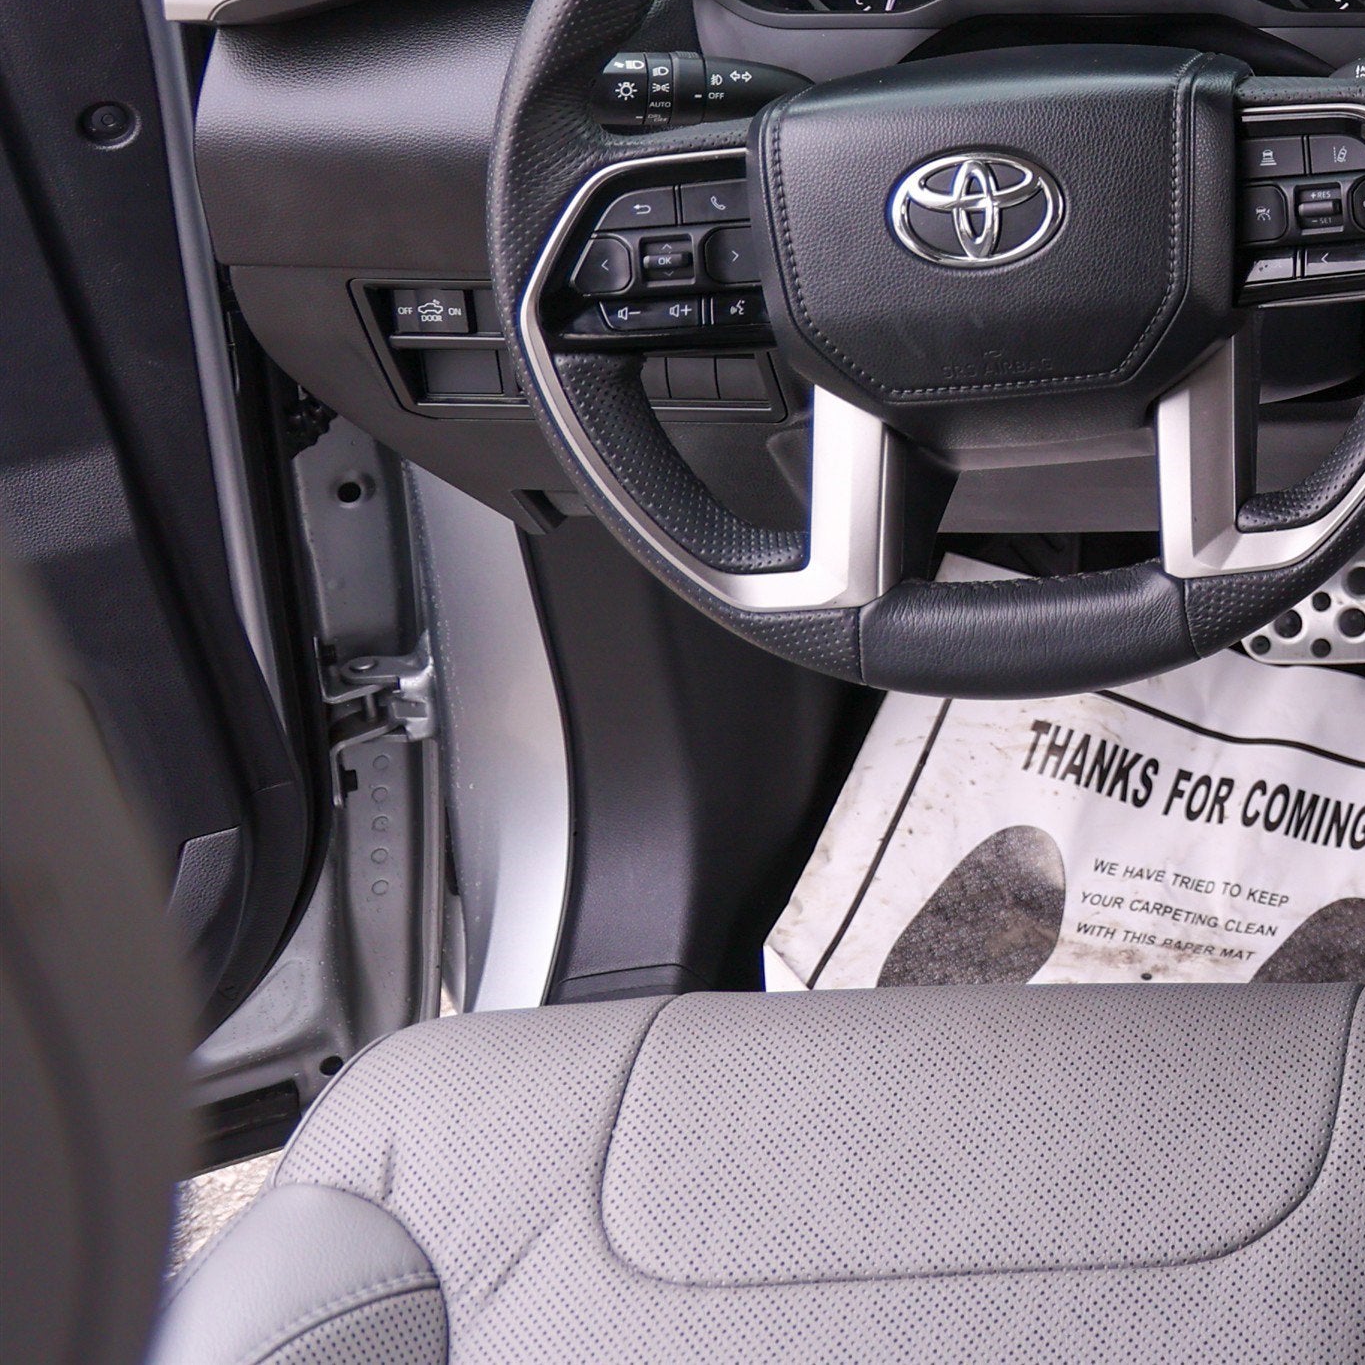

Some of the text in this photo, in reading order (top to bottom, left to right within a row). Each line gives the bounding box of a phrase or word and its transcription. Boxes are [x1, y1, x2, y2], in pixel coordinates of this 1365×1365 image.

[708, 92, 724, 100] OFF
[658, 256, 671, 265] OK
[397, 306, 413, 315] OFF
[448, 307, 462, 316] ON
[1021, 719, 1159, 809] THANKS
[1161, 768, 1234, 824] FOR
[1093, 858, 1290, 908] WE HAVE TRIED TO KEEP
[1080, 891, 1279, 937] YOUR CARPETING CLEAN
[1075, 921, 1116, 940] WITH
[1122, 929, 1156, 947] THIS
[1219, 946, 1256, 962] MAT
